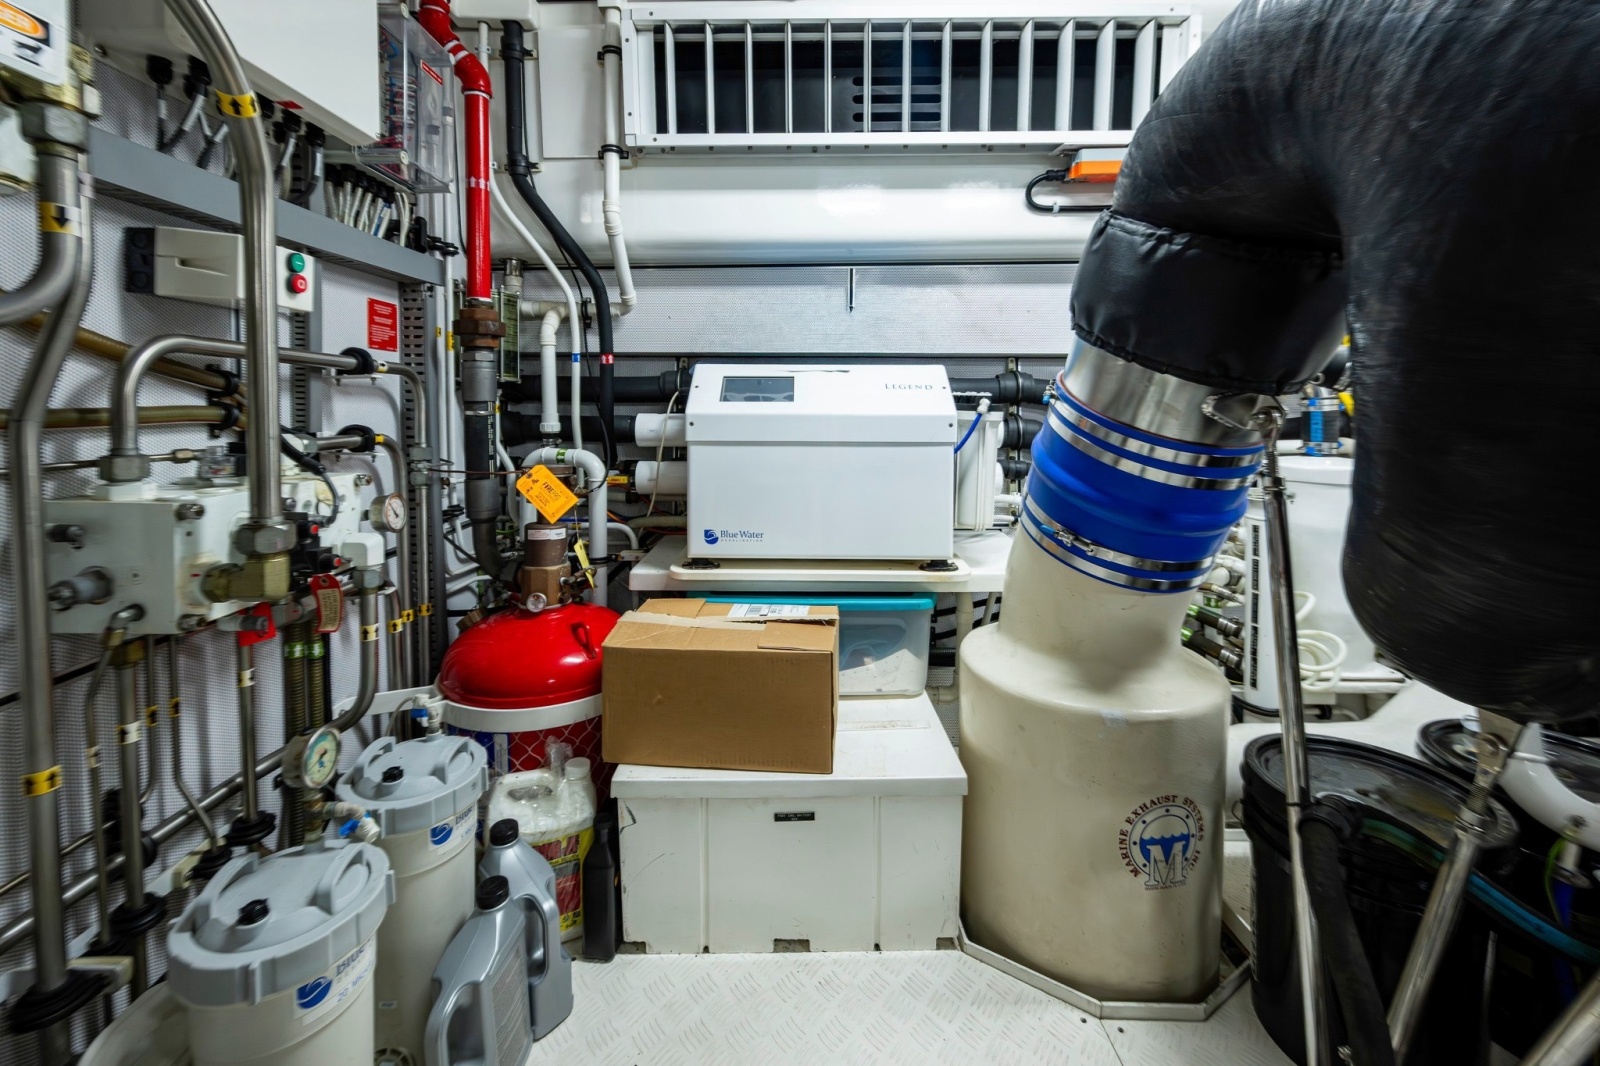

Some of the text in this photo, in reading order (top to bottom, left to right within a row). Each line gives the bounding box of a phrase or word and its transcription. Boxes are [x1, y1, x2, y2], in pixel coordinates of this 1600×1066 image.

[720, 530, 764, 539] Blue Water
[1125, 794, 1178, 826] EXHAUST
[1182, 796, 1205, 842] SYSTEMS
[1119, 828, 1141, 878] MARINE
[1144, 840, 1187, 887] M
